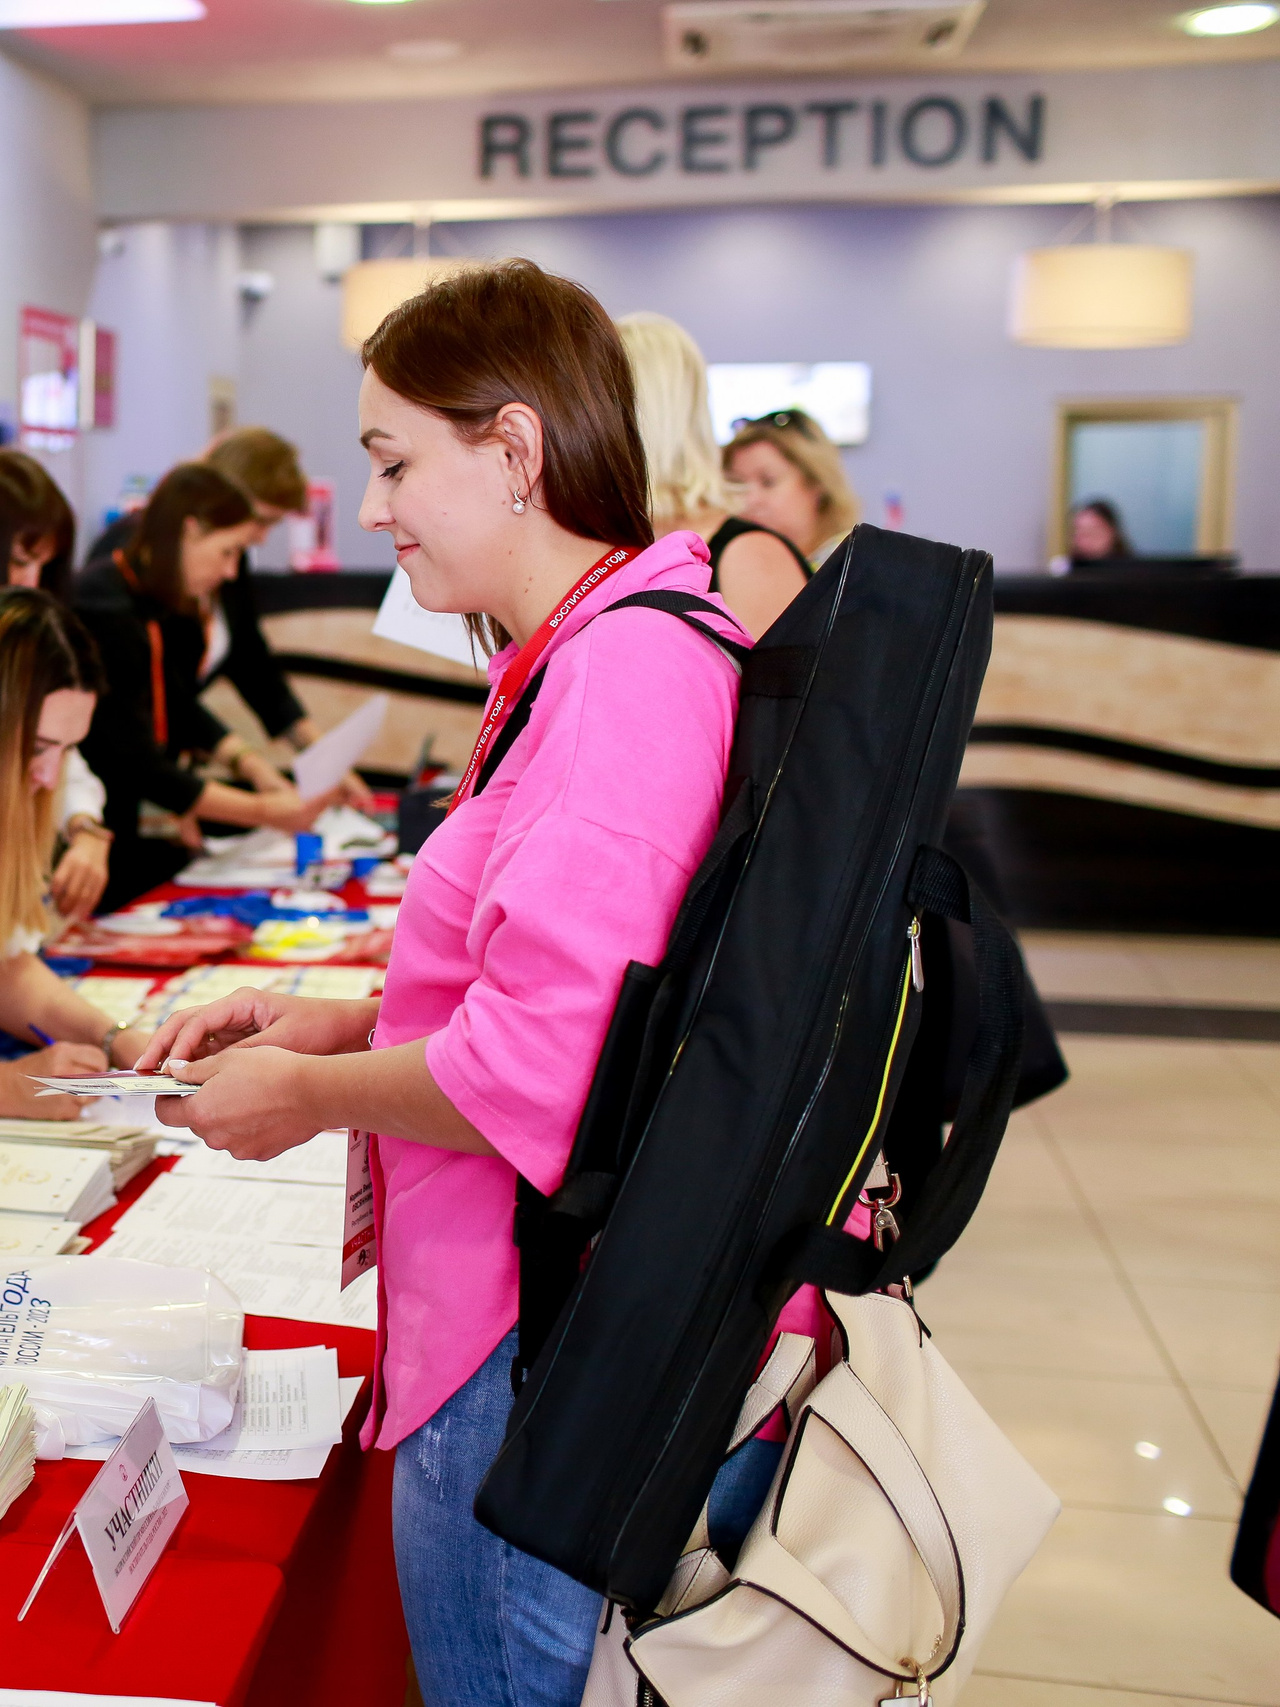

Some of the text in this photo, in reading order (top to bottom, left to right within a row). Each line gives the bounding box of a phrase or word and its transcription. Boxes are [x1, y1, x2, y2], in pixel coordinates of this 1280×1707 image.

[478, 92, 1046, 178] RECEPTION
[549, 549, 629, 628] ВОСПИТАТЕЛЬ ГОДА
[457, 695, 506, 797] ВОСПИТАТЕЛЬ ГОДА
[0, 1269, 32, 1312] ГОДА
[26, 1298, 51, 1324] 2023
[104, 1450, 164, 1552] УЧАСТНИКИ
